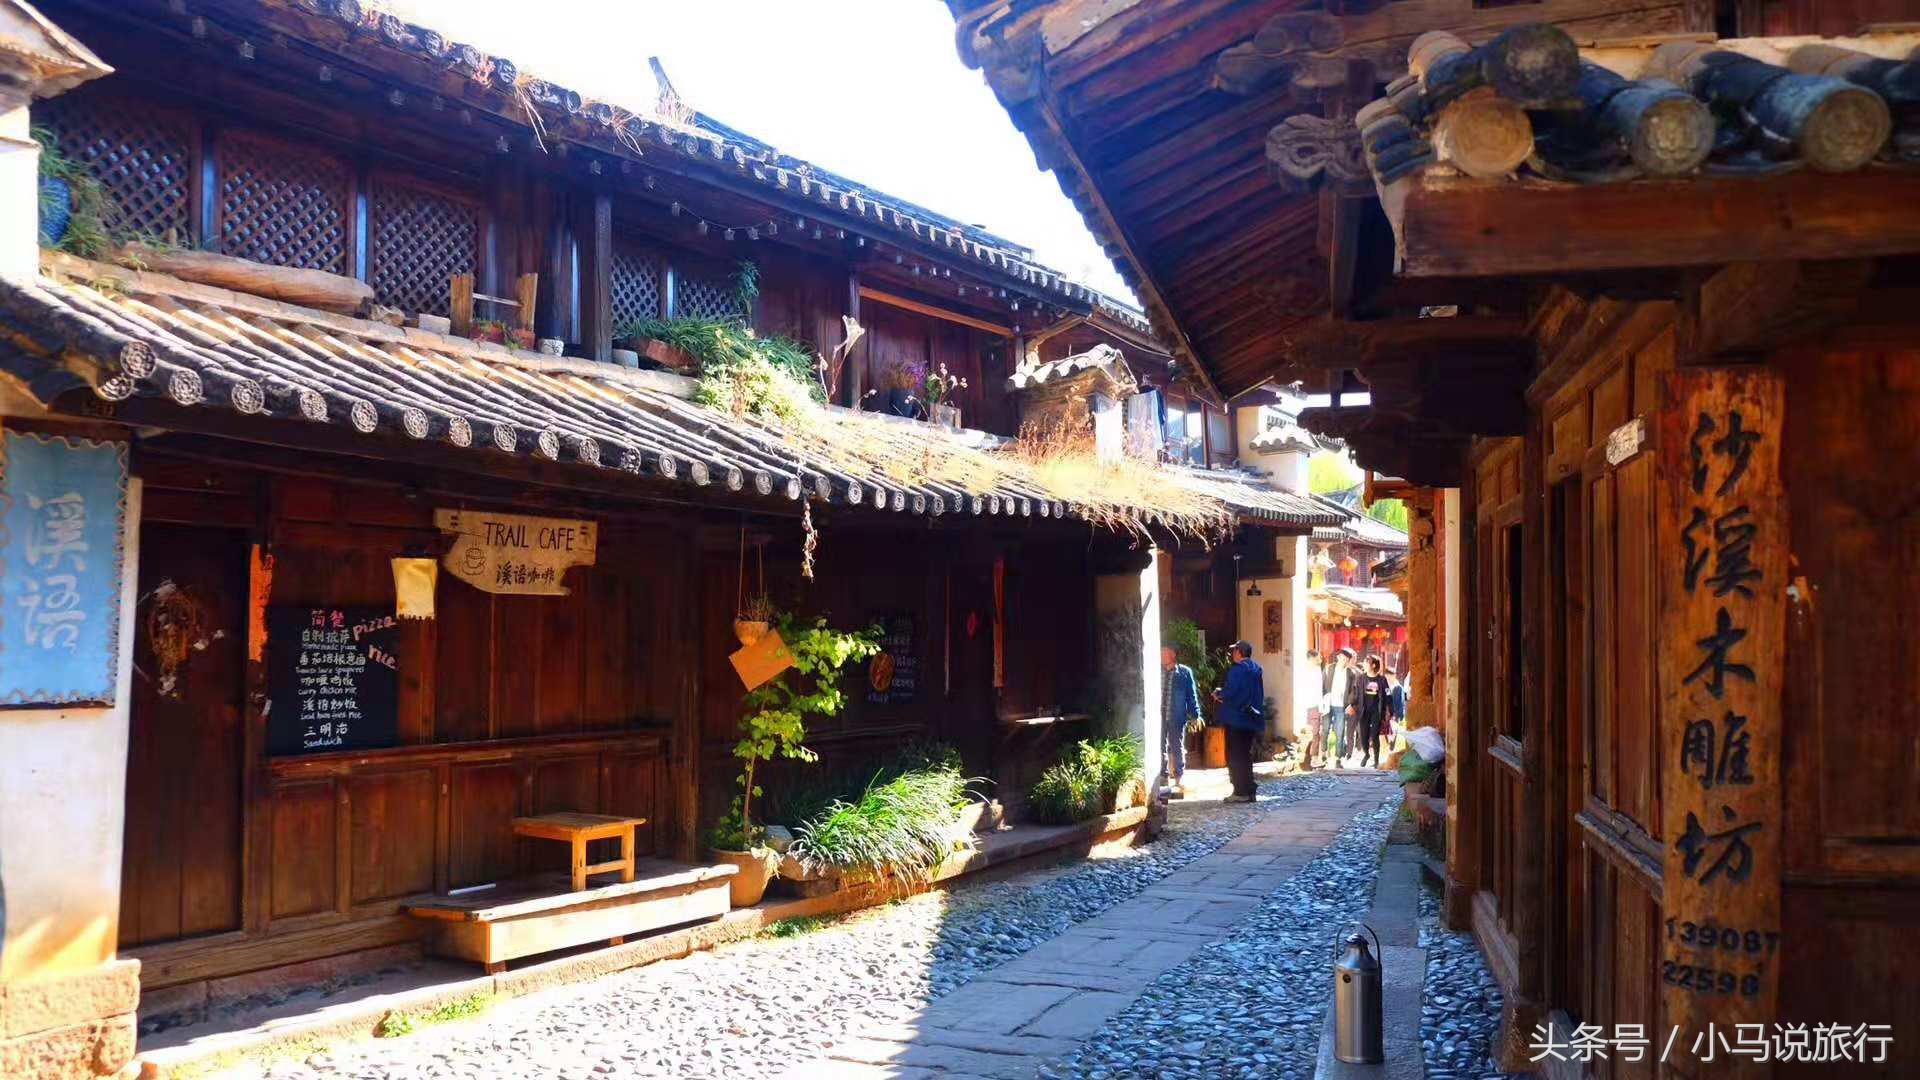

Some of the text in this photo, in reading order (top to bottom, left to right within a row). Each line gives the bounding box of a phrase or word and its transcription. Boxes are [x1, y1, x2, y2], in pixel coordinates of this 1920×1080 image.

[484, 522, 575, 551] TRAIL CAFE
[496, 561, 555, 586] 溪语咖啡
[1675, 410, 1763, 888] 沙溪木雕坊
[303, 722, 349, 738] 三明治
